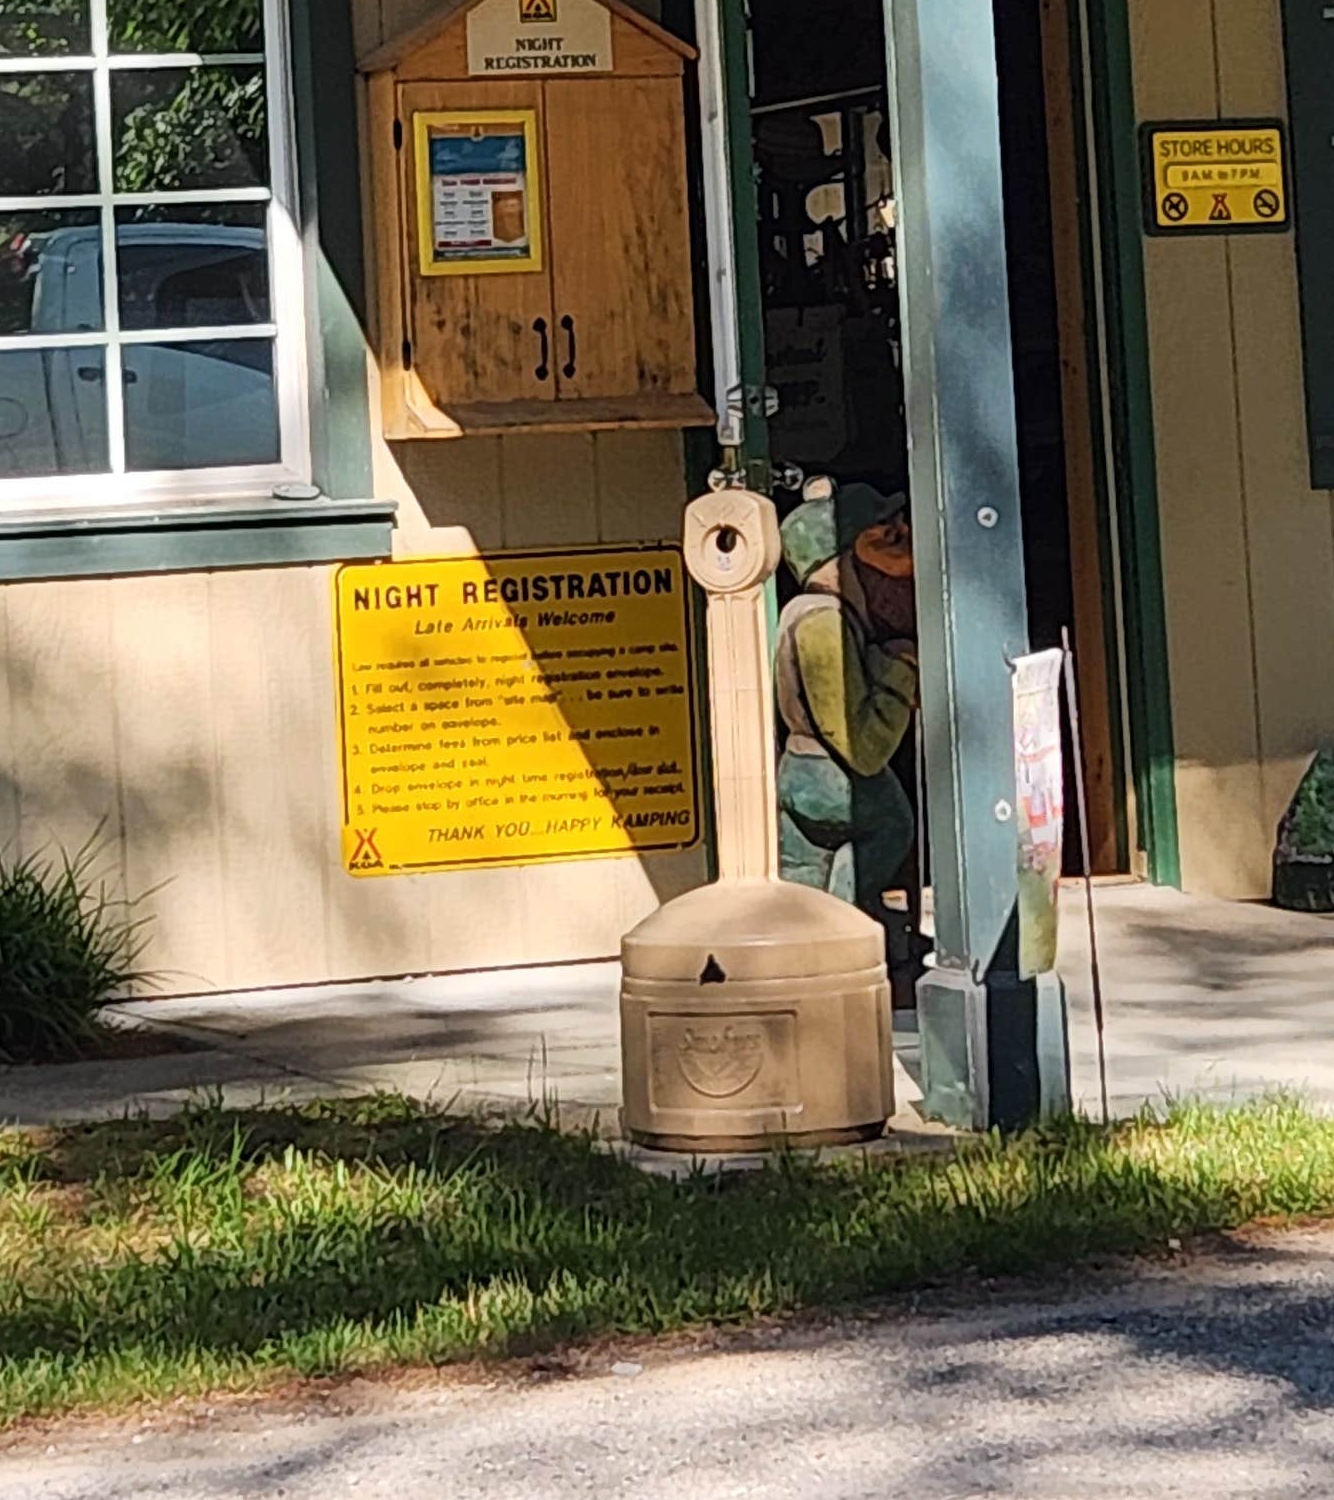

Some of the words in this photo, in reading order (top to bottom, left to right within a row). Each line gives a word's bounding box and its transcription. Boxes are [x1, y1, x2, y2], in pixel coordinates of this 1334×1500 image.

[515, 37, 565, 52] NIGHT
[484, 53, 597, 71] REGISTRATION
[1159, 139, 1213, 157] STORE
[1216, 137, 1275, 155] HOURS
[354, 584, 439, 611] NIGHT
[463, 568, 672, 604] REGISTRATION
[415, 619, 453, 635] Late
[462, 615, 528, 632] Arrivals
[537, 609, 616, 628] Welcome
[365, 683, 383, 694] Fill
[495, 674, 526, 688] night
[366, 702, 405, 715] Select
[423, 699, 460, 713] space
[465, 696, 494, 708] from
[367, 721, 415, 735] number
[420, 719, 436, 731] on
[369, 739, 433, 756] Determine
[438, 737, 467, 749] fees
[473, 735, 502, 748] from
[506, 732, 538, 748] price
[542, 731, 563, 743] list
[370, 760, 427, 775] envelope
[432, 759, 456, 771] and
[371, 782, 401, 796] Drop
[407, 778, 464, 793] envelope
[469, 776, 479, 787] in
[485, 773, 516, 789] night
[522, 771, 548, 784] time
[371, 803, 410, 815] Please
[415, 800, 441, 814] stop
[446, 798, 461, 811] by
[465, 795, 500, 809] office
[505, 793, 515, 805] in
[519, 792, 537, 804] the
[429, 824, 484, 843] THANK
[611, 810, 690, 830] KAMPING
